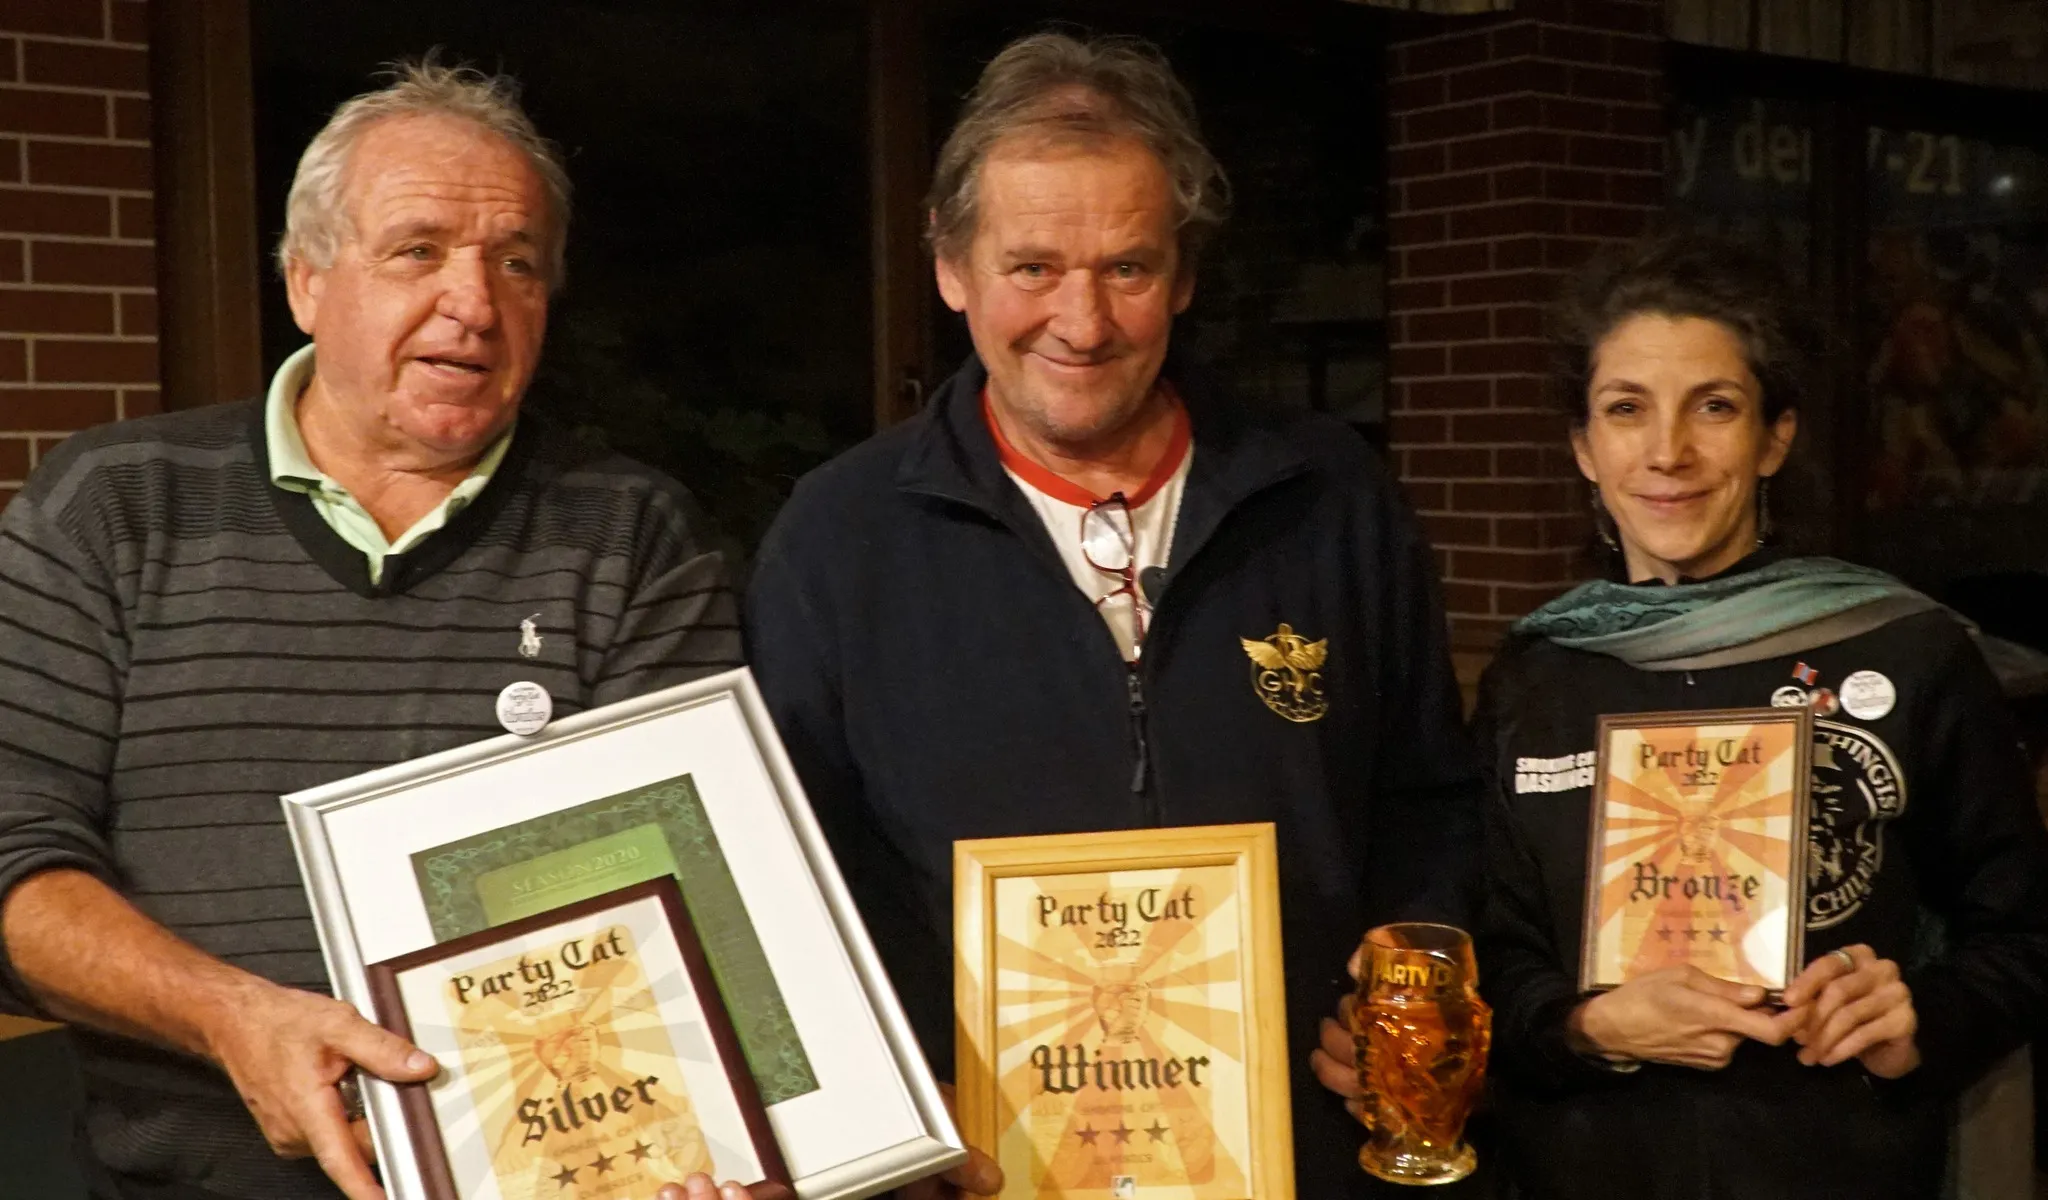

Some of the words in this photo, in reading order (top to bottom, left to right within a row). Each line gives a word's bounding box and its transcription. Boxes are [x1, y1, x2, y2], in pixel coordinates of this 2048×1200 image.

[1639, 741, 1709, 770] Party
[1037, 892, 1127, 929] Party
[1137, 885, 1196, 922] Cat
[1629, 862, 1761, 912] Bronze
[1094, 928, 1141, 948] 2022
[451, 955, 555, 1004] Party
[560, 927, 627, 970] Cat
[1378, 963, 1430, 987] ARTY
[523, 979, 575, 1008] 2022
[1031, 1044, 1211, 1095] Winner
[516, 1072, 660, 1148] Silver
